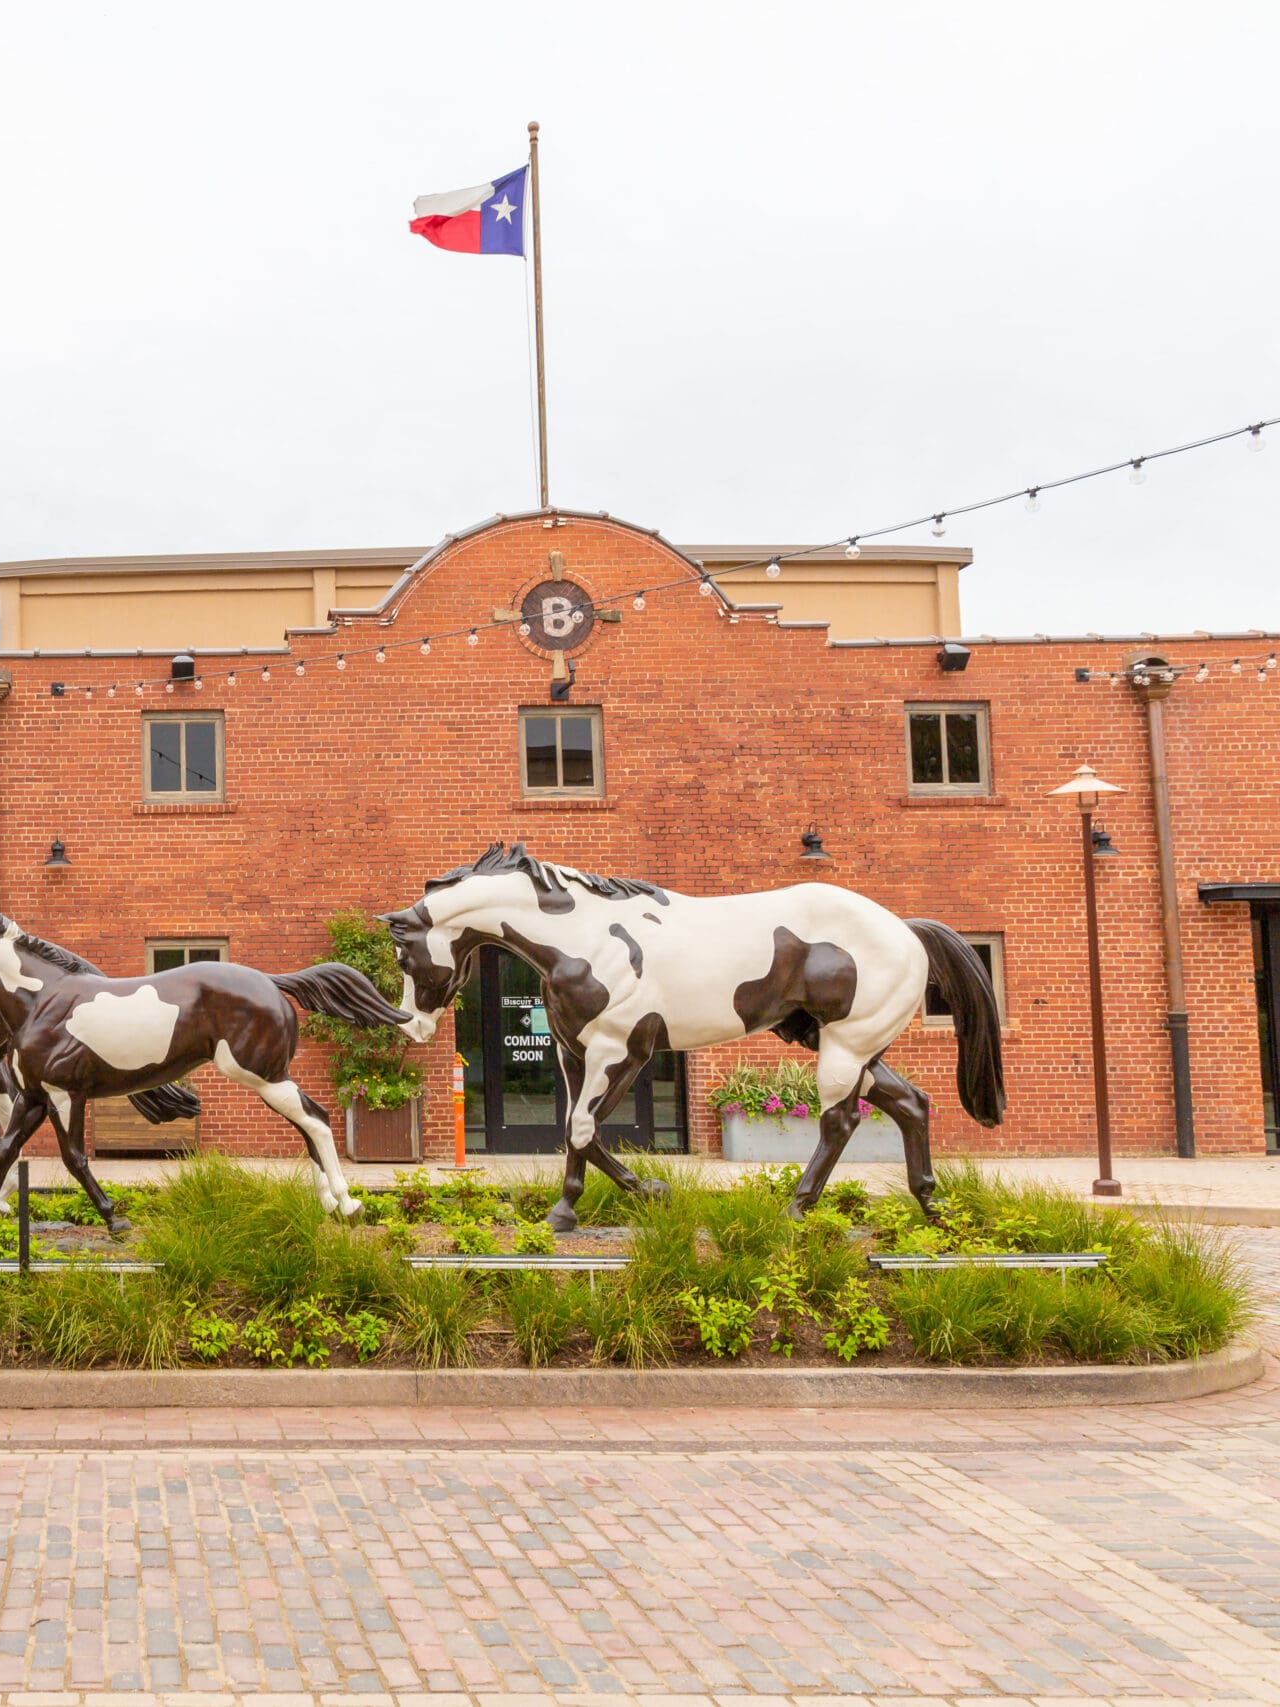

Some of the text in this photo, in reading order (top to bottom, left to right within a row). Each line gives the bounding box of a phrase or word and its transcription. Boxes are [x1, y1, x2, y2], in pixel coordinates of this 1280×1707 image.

[542, 596, 575, 637] B
[504, 1035, 551, 1047] COMING
[512, 1050, 544, 1061] SOON
